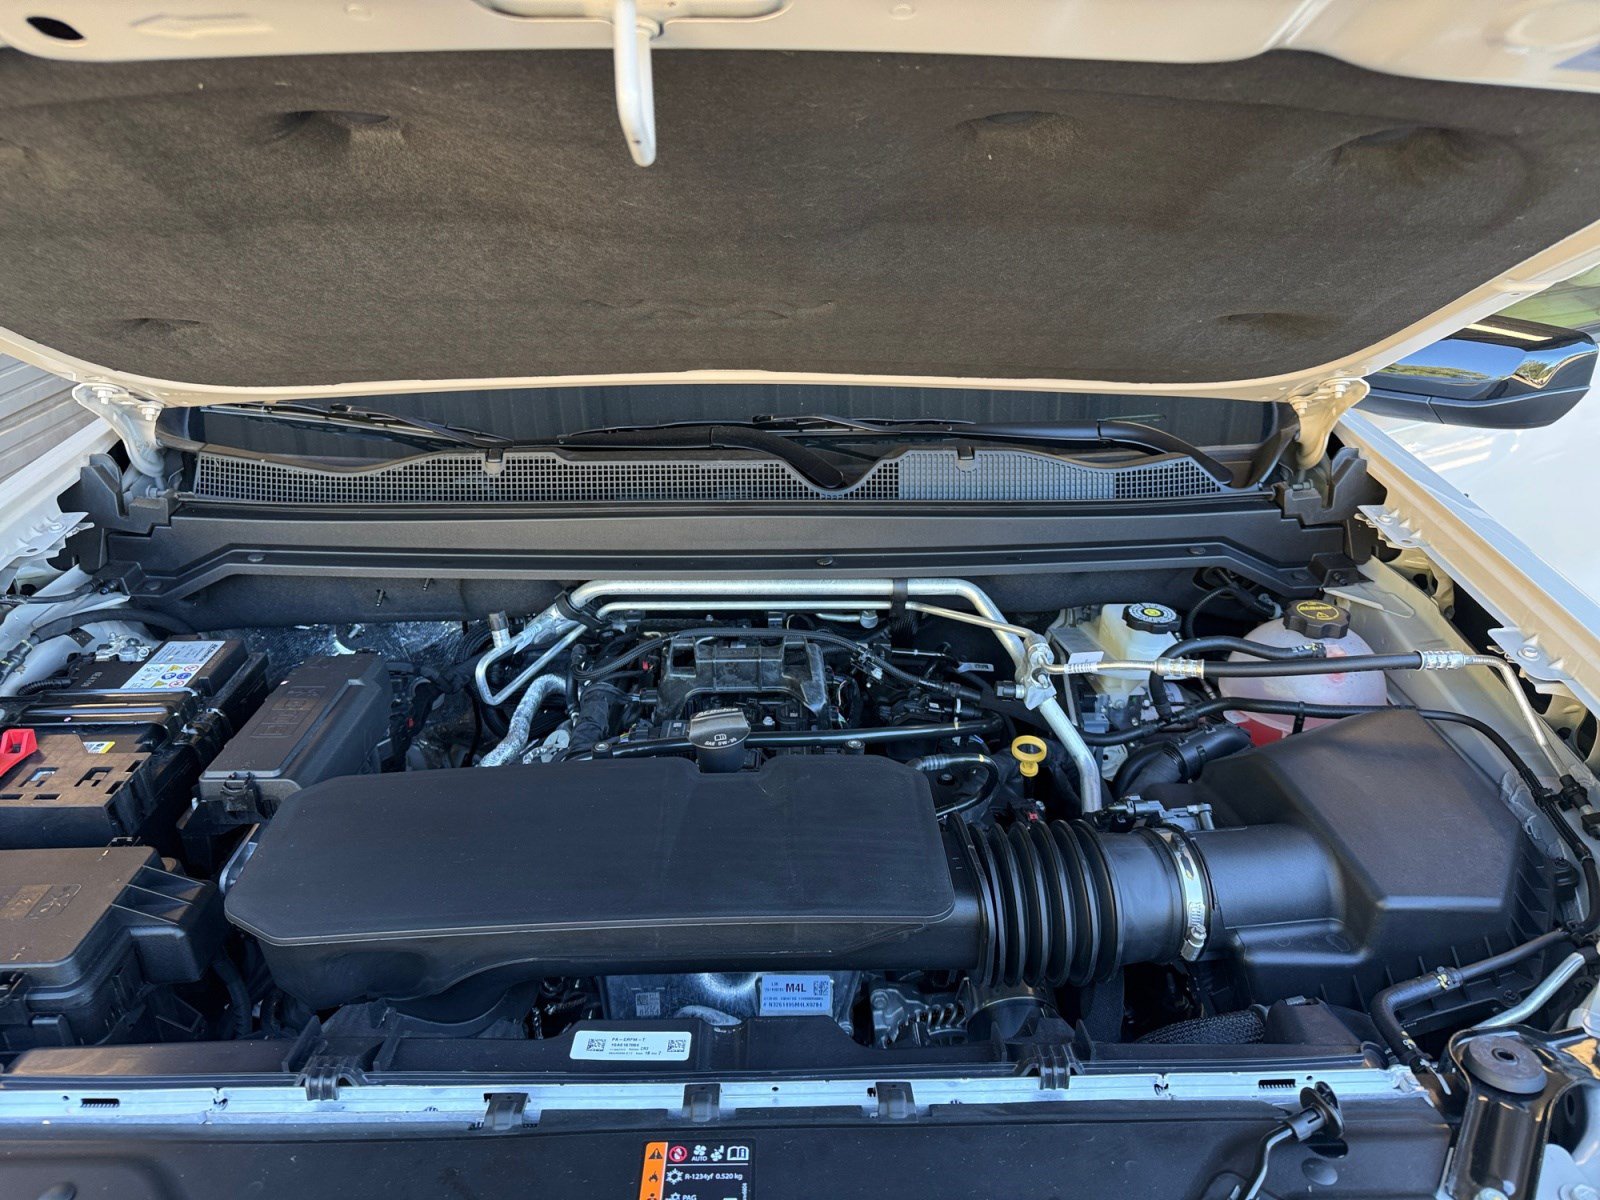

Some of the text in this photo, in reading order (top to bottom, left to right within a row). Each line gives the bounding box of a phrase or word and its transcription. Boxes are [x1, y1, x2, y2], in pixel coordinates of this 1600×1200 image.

[694, 707, 739, 718] ACDelco
[785, 983, 807, 993] M4L
[684, 1172, 714, 1181] R-1234yf
[734, 1172, 743, 1181] kg
